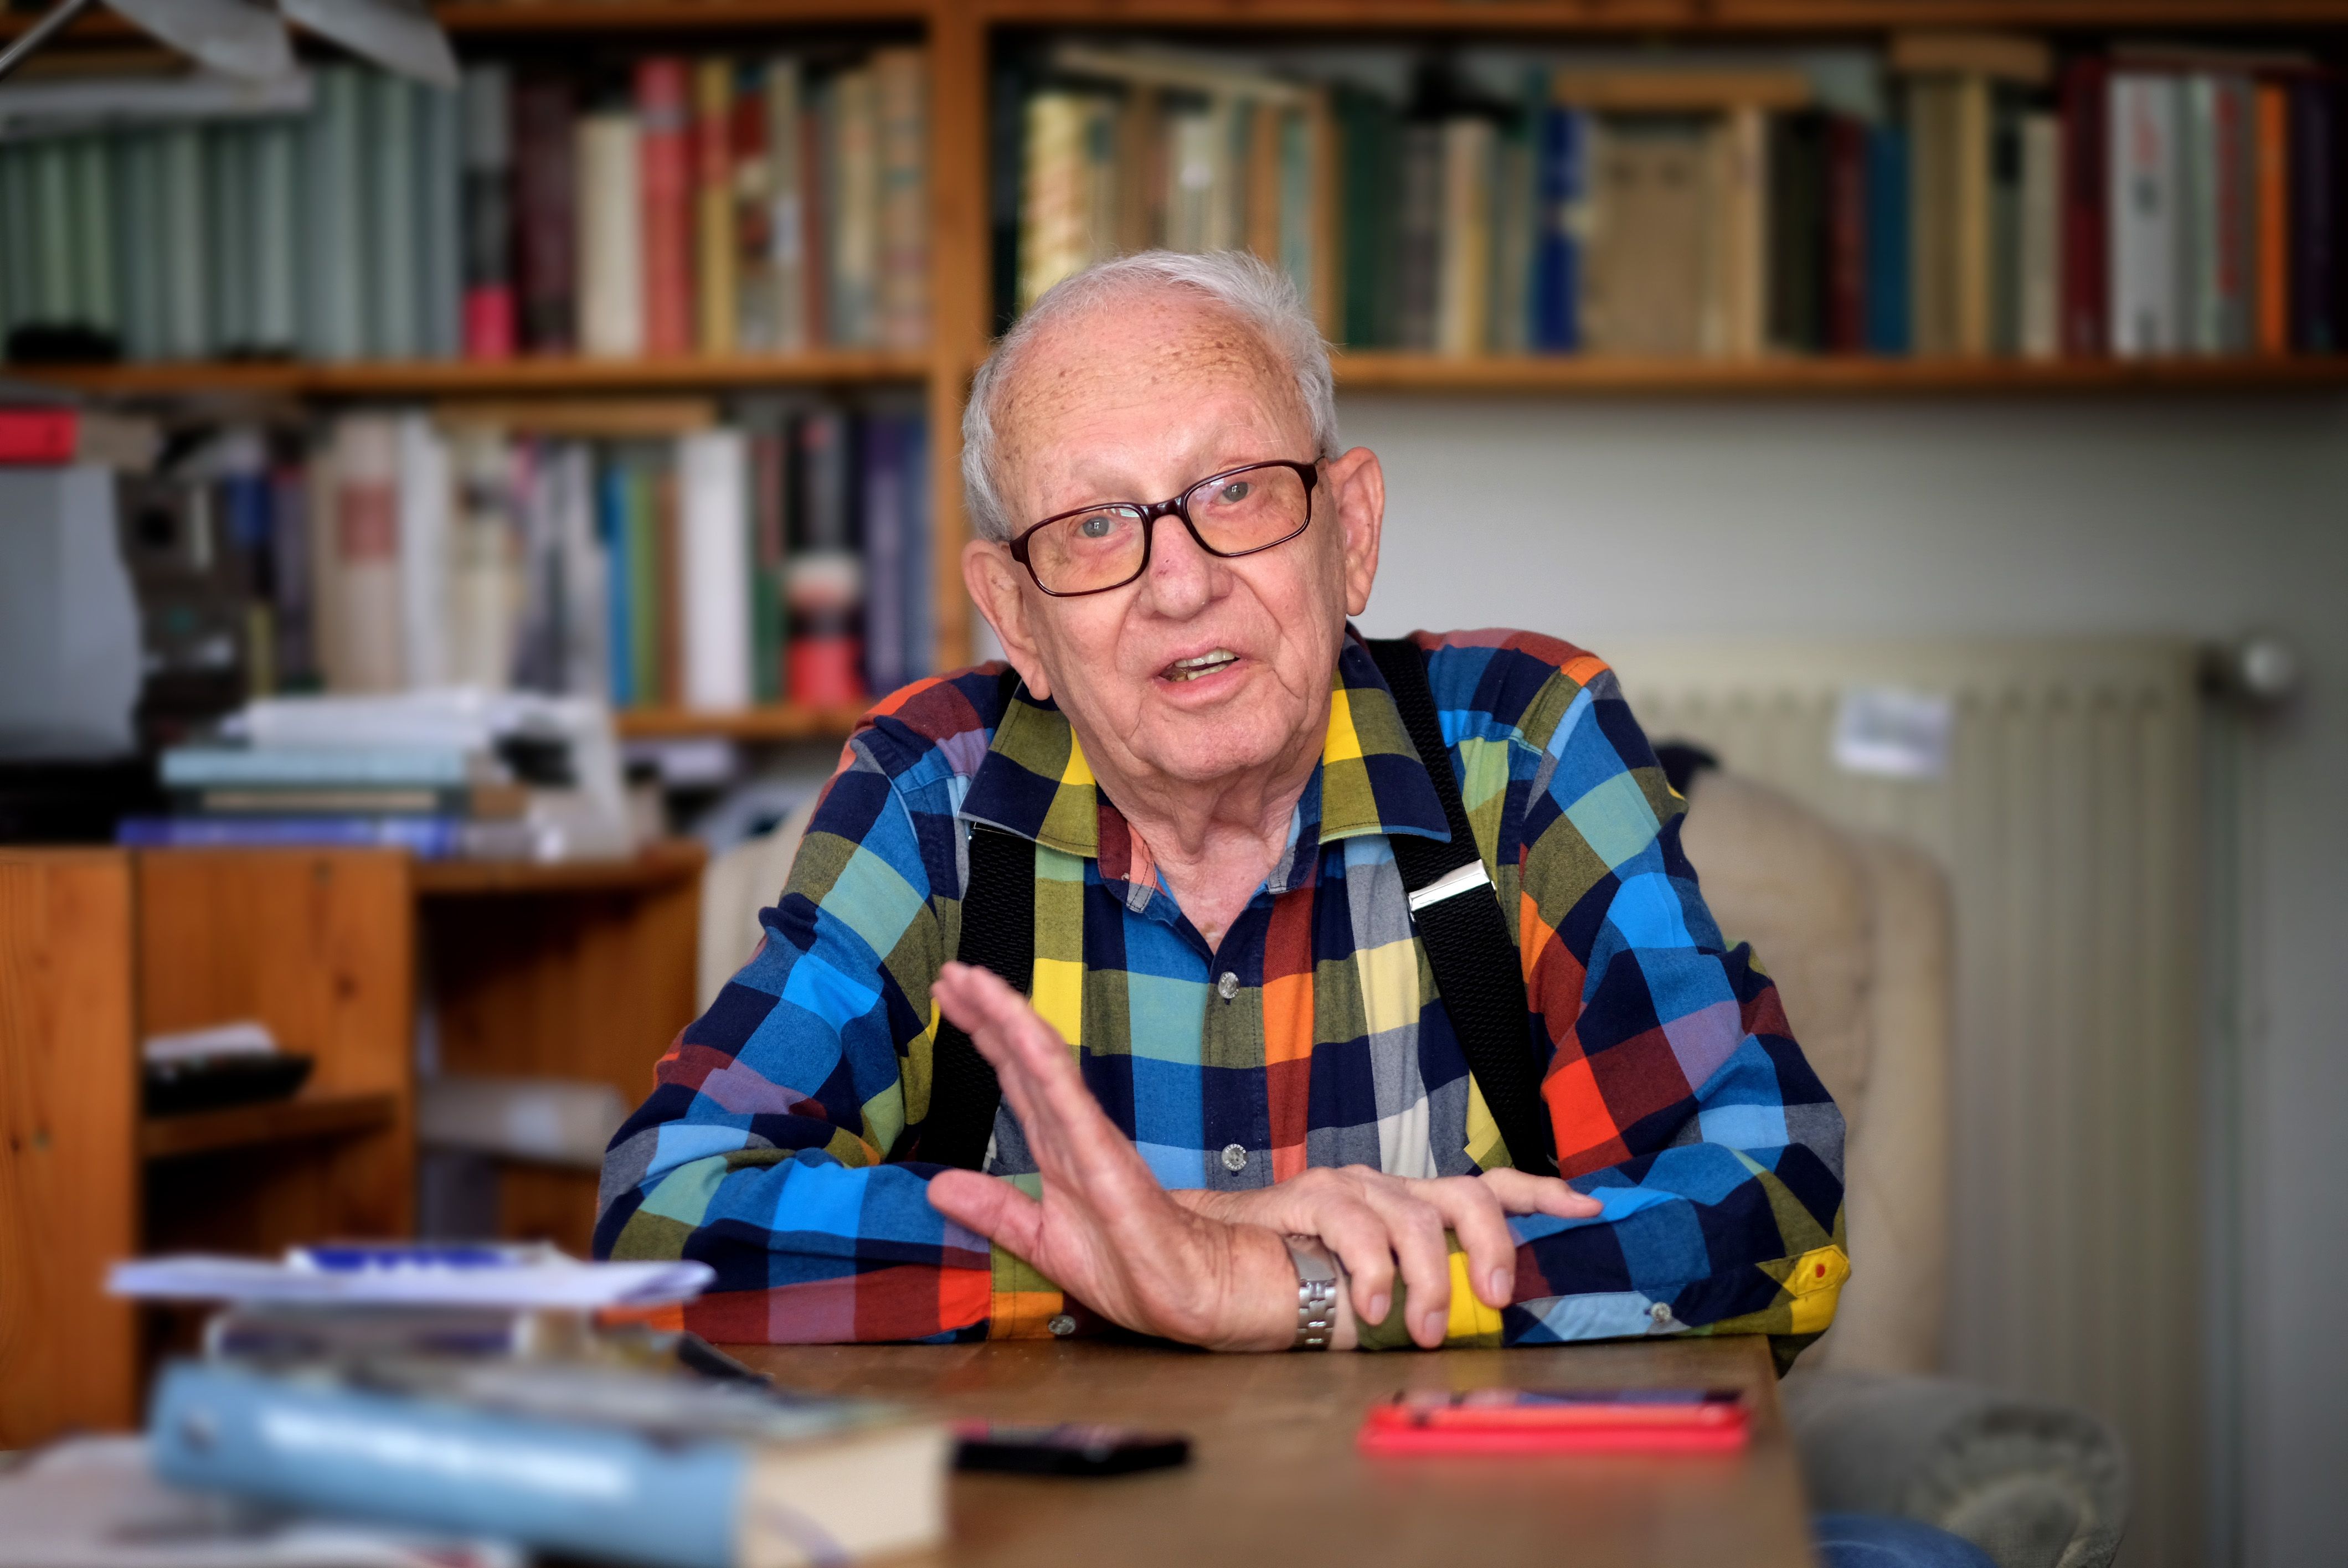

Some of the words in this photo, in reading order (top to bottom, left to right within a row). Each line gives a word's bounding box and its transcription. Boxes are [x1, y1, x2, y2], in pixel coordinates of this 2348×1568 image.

[1221, 972, 1238, 982] KLEPR
[1225, 1144, 1246, 1153] KLEPPER
[1225, 1160, 1247, 1169] KLEPPER
